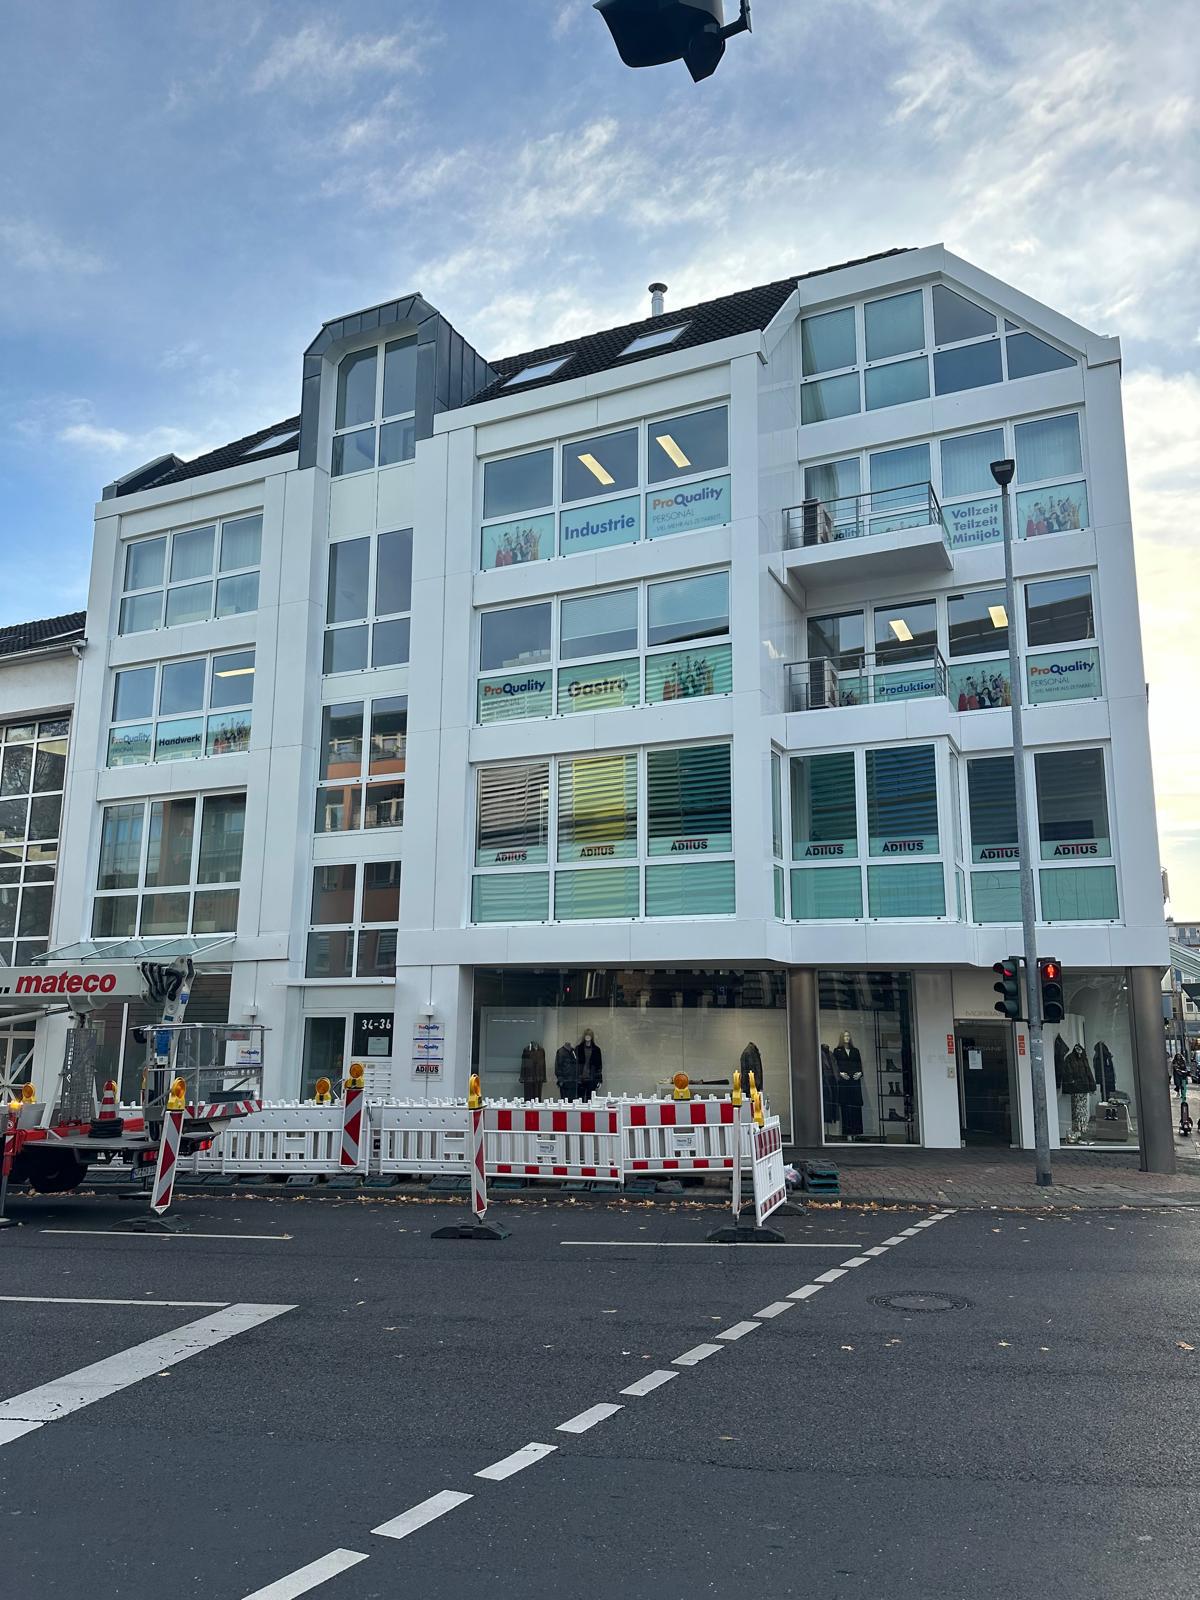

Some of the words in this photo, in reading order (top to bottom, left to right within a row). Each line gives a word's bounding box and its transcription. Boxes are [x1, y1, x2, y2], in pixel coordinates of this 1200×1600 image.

[653, 487, 723, 510] ProQuality
[652, 509, 695, 523] PERSONAL
[952, 504, 998, 519] Vollzeit
[564, 515, 635, 540] Industrie
[954, 517, 998, 531] Teilzeit
[952, 529, 1000, 544] Minijob
[1030, 660, 1095, 676] ProQuality
[484, 679, 546, 696] ProQuality
[567, 678, 629, 698] Gastro
[1031, 677, 1070, 688] PERSONAL
[111, 732, 151, 745] ProQuality
[158, 733, 201, 747] Handwerk
[580, 844, 616, 857] ADITUS
[671, 838, 709, 851] ADITUS
[805, 843, 845, 856] ADITUS
[882, 839, 925, 852] ADITUS
[1053, 842, 1098, 856] ADITUS
[495, 850, 528, 862] ADITUS
[15, 971, 117, 994] mateco
[361, 1018, 392, 1030] 34-36
